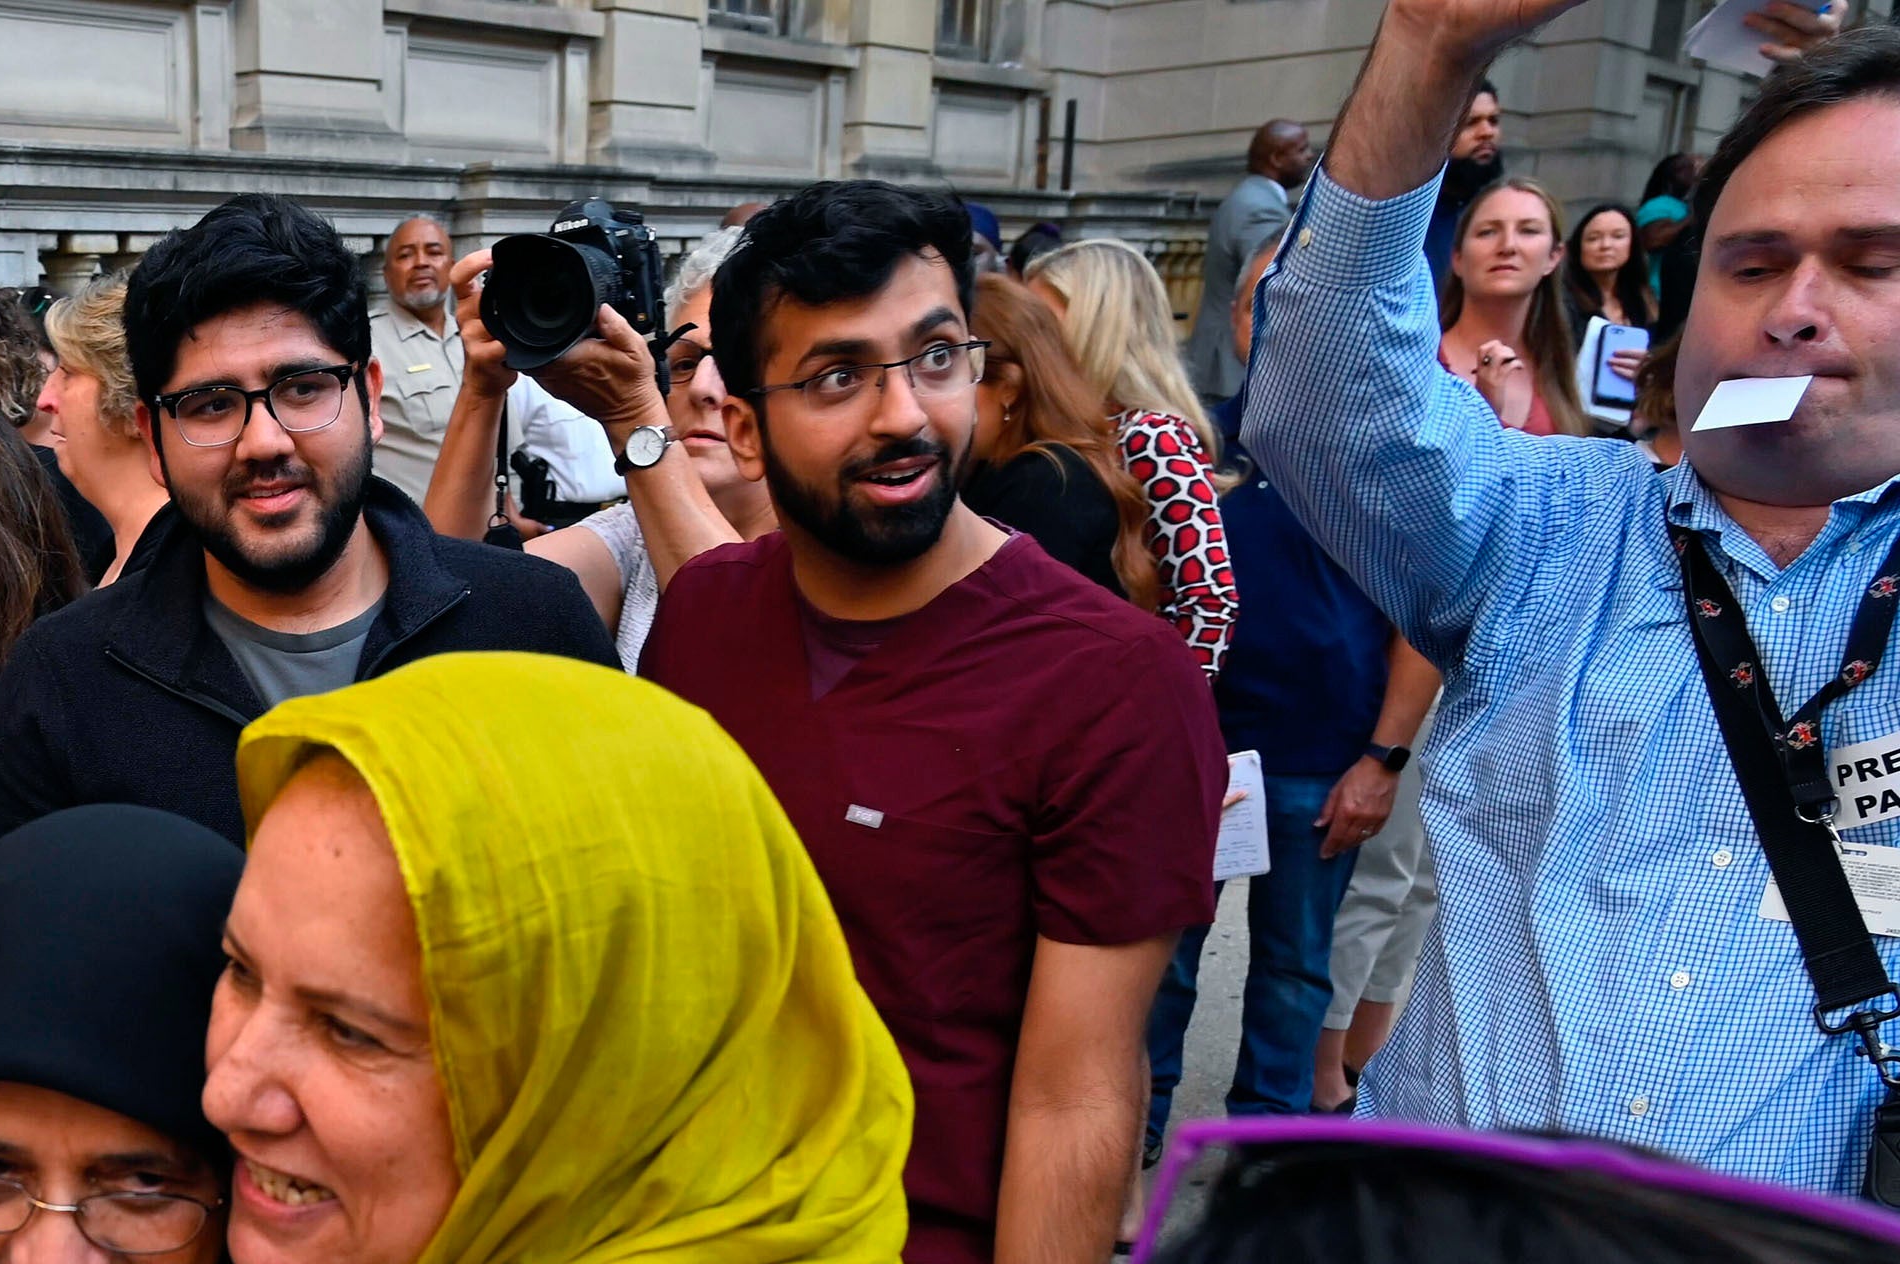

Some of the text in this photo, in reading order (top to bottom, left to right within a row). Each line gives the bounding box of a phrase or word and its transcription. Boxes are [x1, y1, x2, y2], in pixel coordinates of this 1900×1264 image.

[553, 218, 589, 233] Nikon
[1836, 748, 1900, 787] PRE
[1853, 789, 1900, 819] PA
